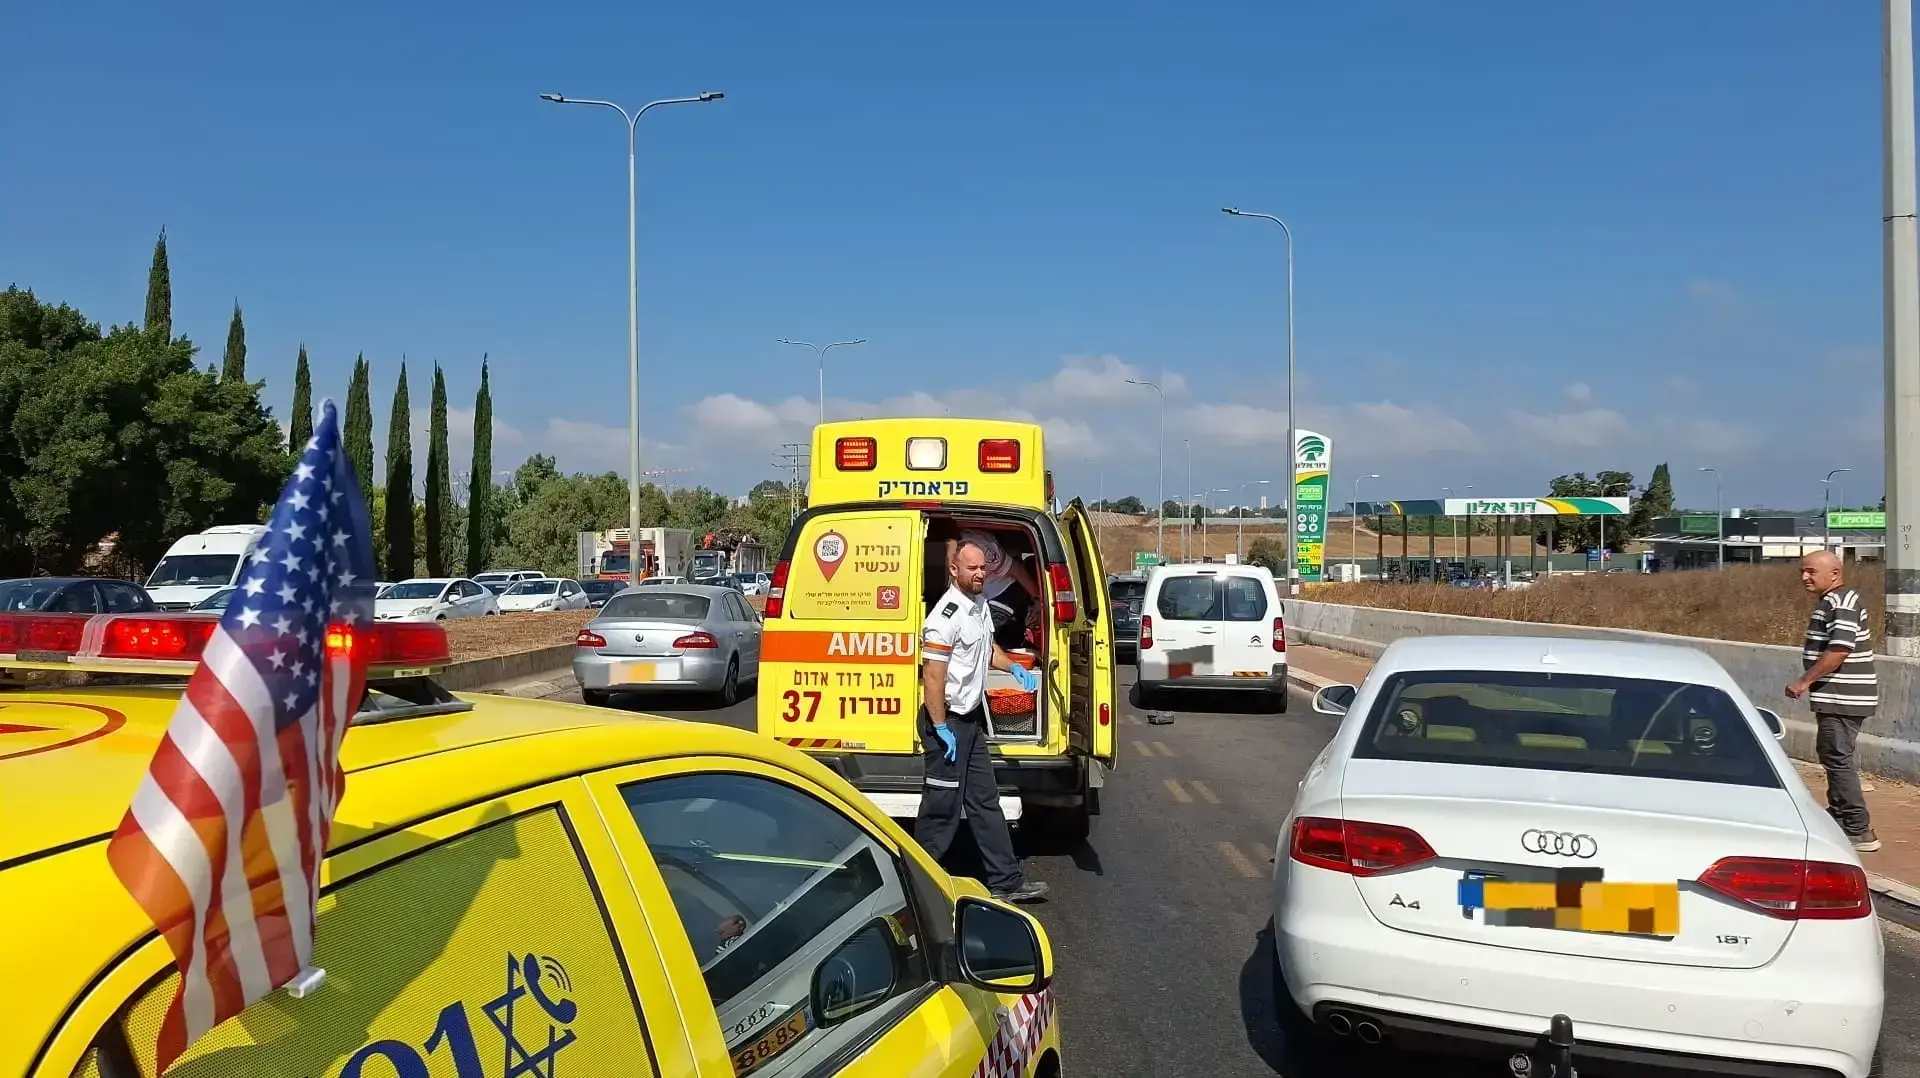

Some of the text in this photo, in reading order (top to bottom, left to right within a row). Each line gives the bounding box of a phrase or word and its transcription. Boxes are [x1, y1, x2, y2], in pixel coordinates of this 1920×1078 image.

[878, 480, 969, 498] פראמדיק
[1466, 501, 1537, 514] דור אלון
[856, 545, 900, 556] הורידו
[855, 561, 900, 573] עכשיו
[827, 632, 914, 657] AMBU
[794, 669, 894, 690] מגן דוד אדום
[782, 689, 901, 723] שרון 37
[1388, 893, 1421, 910] A4
